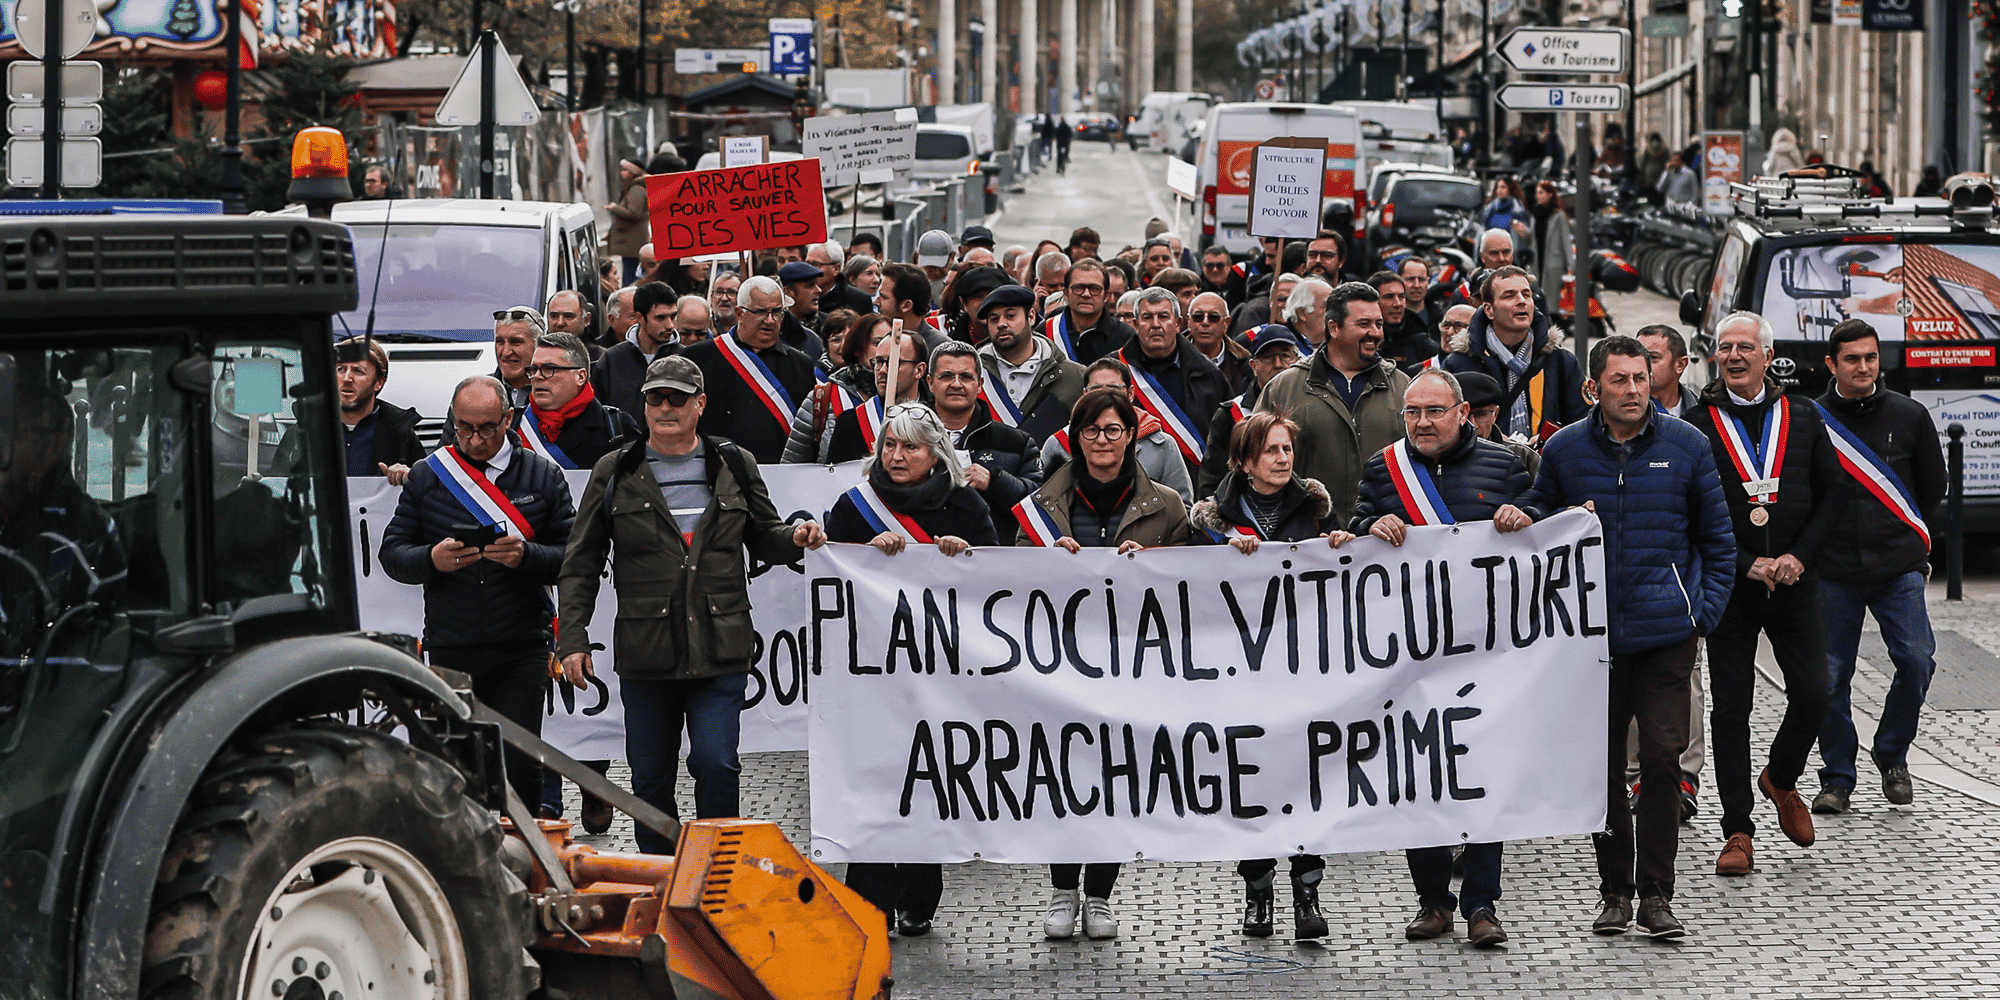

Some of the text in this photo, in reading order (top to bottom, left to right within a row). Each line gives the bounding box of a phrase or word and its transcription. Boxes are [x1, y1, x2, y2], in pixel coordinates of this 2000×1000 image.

[1542, 36, 1579, 49] Office
[1542, 53, 1616, 66] de Tourisme
[1570, 91, 1616, 107] Tourny
[870, 123, 912, 132] TRINQUENT
[854, 138, 882, 148] SUICIDES
[836, 158, 872, 171] LARMES
[1264, 154, 1316, 164] VITICULTURE
[677, 164, 802, 199] ARRACHER
[1277, 174, 1297, 184] LES
[1264, 184, 1310, 195] OUBLIES
[669, 189, 798, 217] POUR SAUVER
[1278, 197, 1295, 206] DU
[1261, 207, 1309, 219] POUVOIR
[667, 210, 810, 250] DES VIES
[1911, 320, 1955, 333] VELUX
[1910, 349, 1991, 358] CONTRAT D'ENTRETIEN
[1931, 356, 1971, 365] DE TOITURE
[1941, 411, 1970, 420] Pascal
